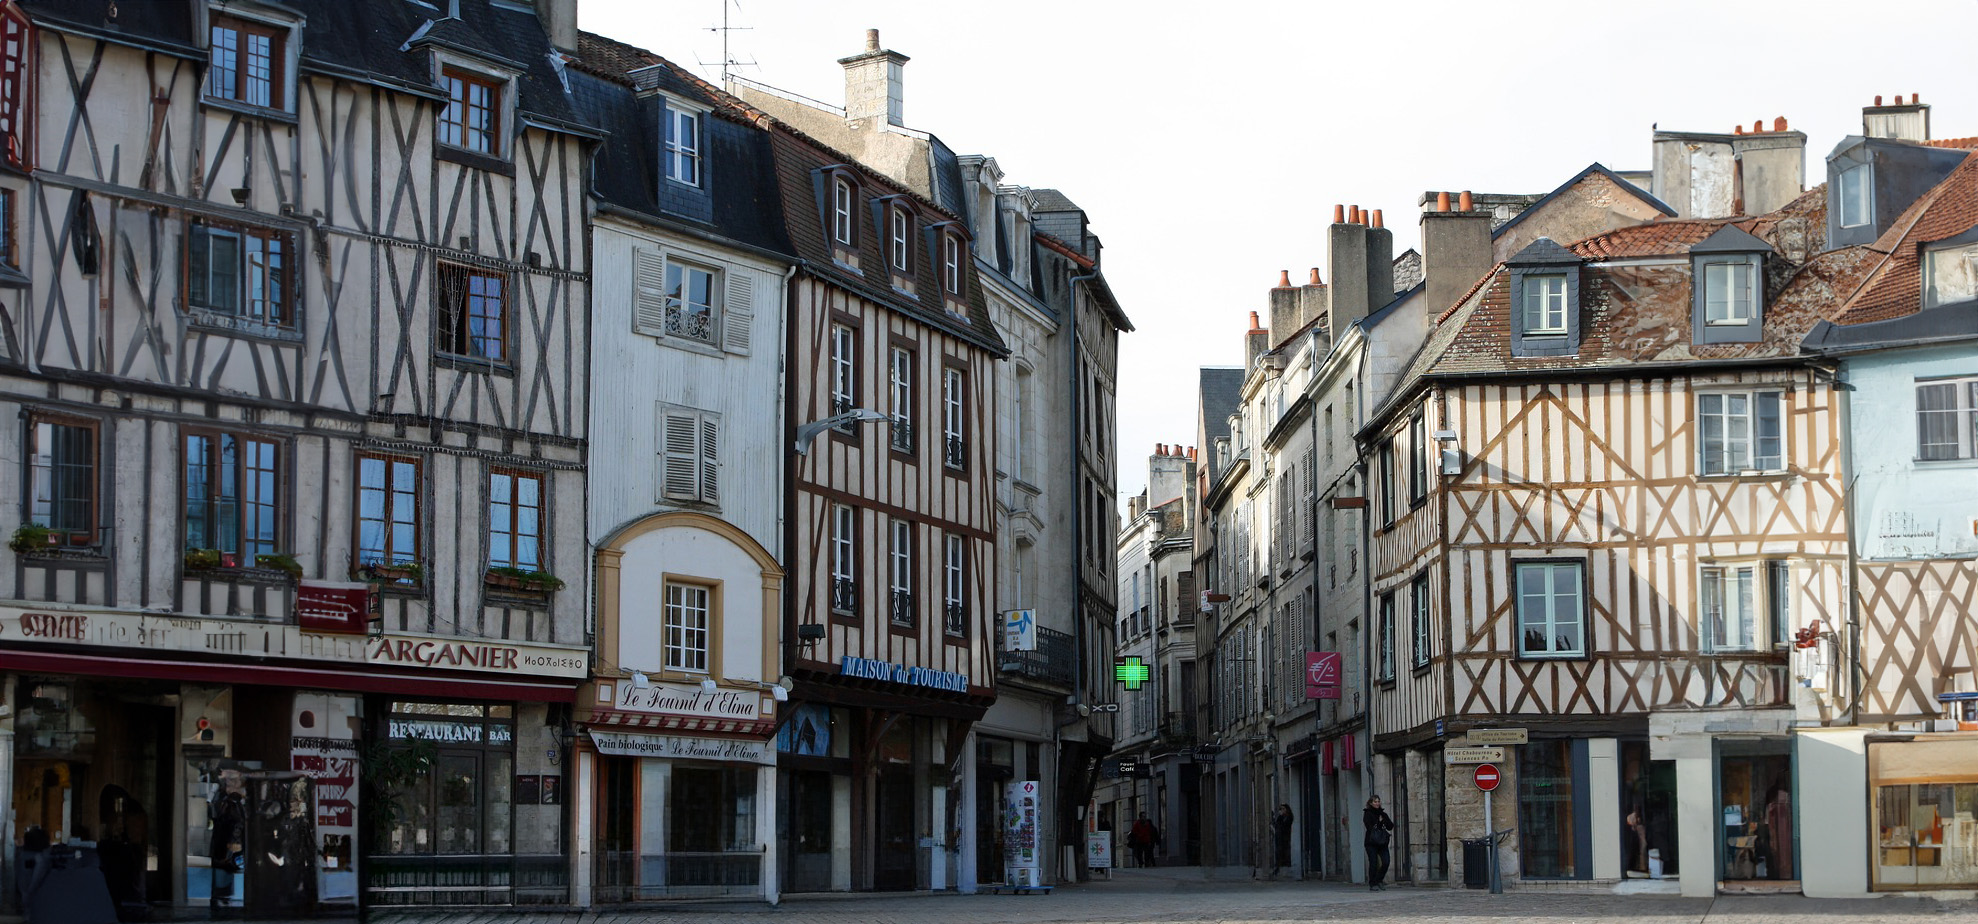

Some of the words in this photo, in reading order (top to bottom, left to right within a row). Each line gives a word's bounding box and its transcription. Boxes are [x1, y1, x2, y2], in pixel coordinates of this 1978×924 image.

[845, 656, 892, 681] MAISON
[896, 663, 909, 684] du
[914, 667, 968, 693] TOURISME
[621, 683, 640, 707] Le
[647, 685, 701, 712] Fournil
[704, 690, 754, 716] d'Elina
[389, 722, 482, 742] RESTAURANT
[489, 730, 512, 741] BAR
[598, 738, 616, 749] Pain
[618, 739, 664, 753] biologique
[672, 740, 684, 755] Le
[685, 741, 722, 758] Fournil
